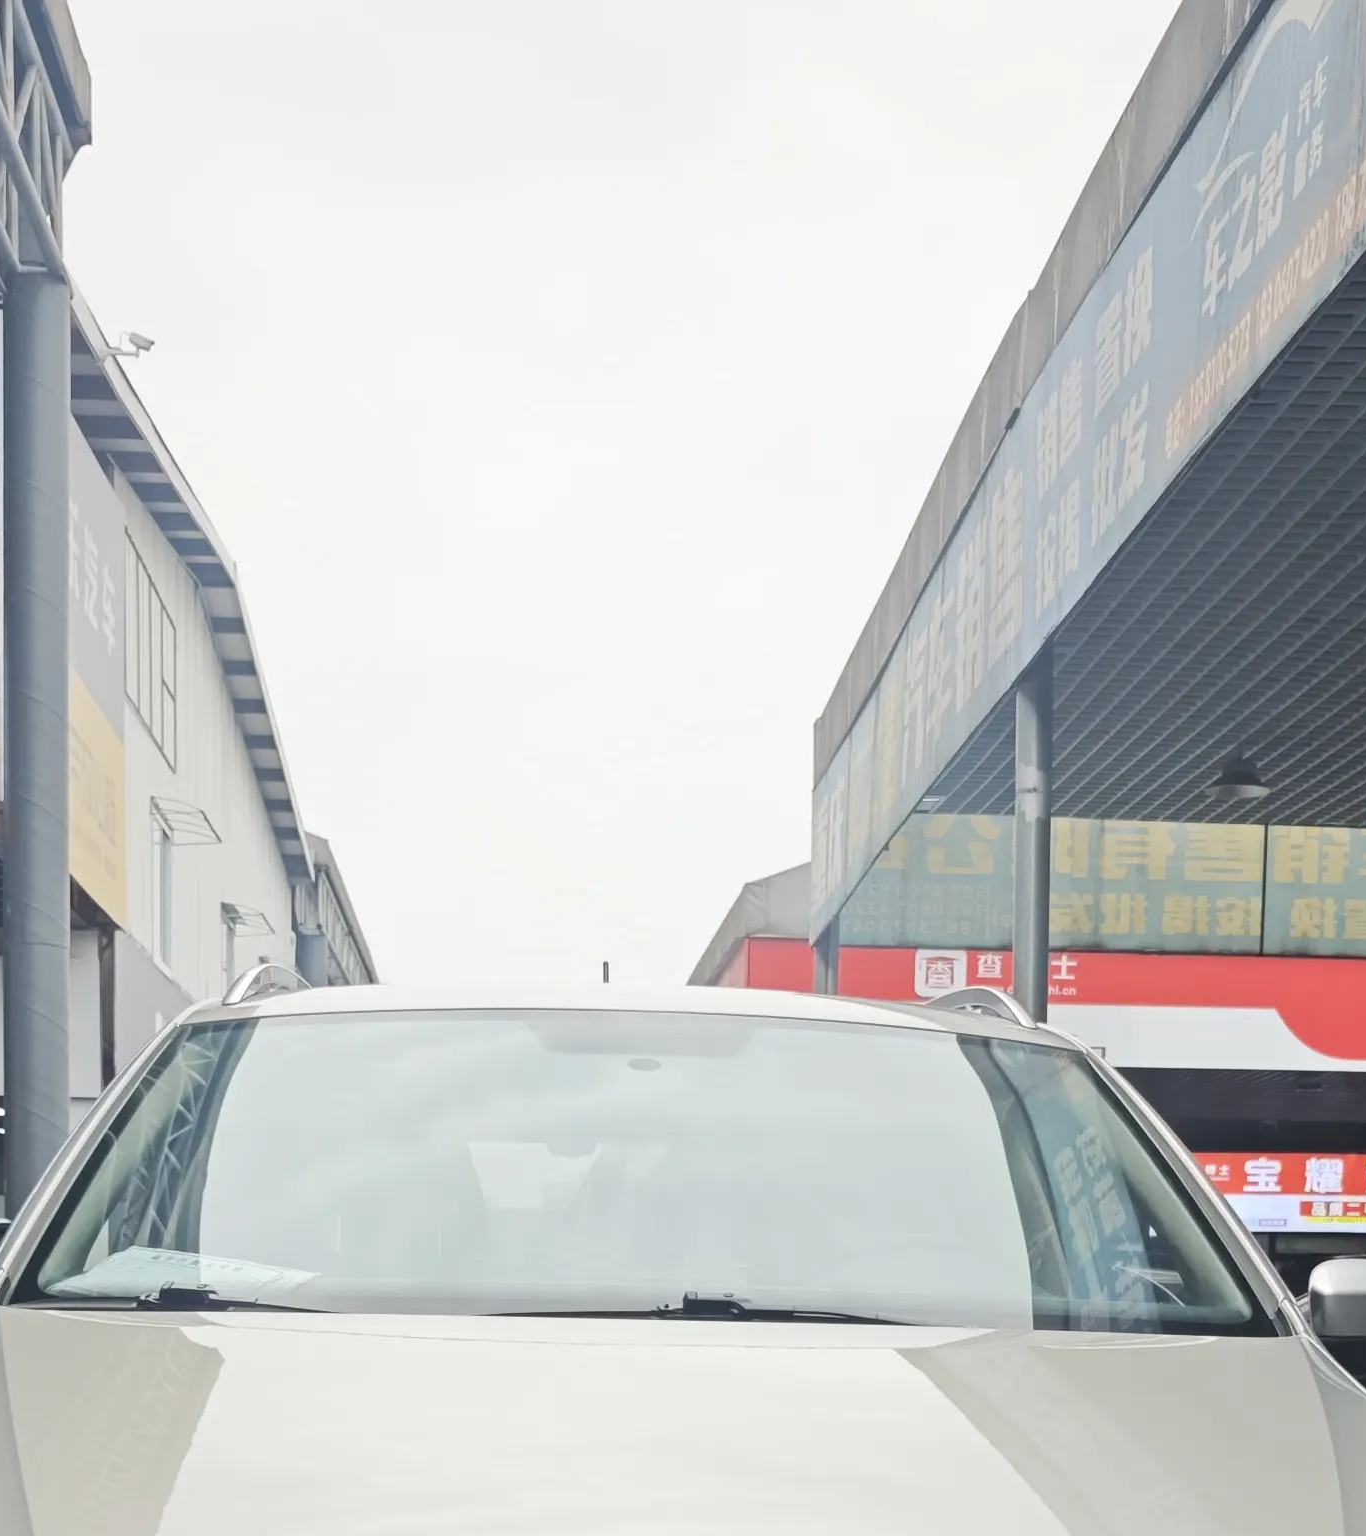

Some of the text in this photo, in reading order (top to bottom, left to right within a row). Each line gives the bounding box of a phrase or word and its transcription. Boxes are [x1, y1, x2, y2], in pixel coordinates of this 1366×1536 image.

[1201, 111, 1289, 317] 车之影
[1037, 246, 1154, 500] 销售 置换
[1091, 381, 1150, 549] 批发
[976, 953, 1078, 980] 查士
